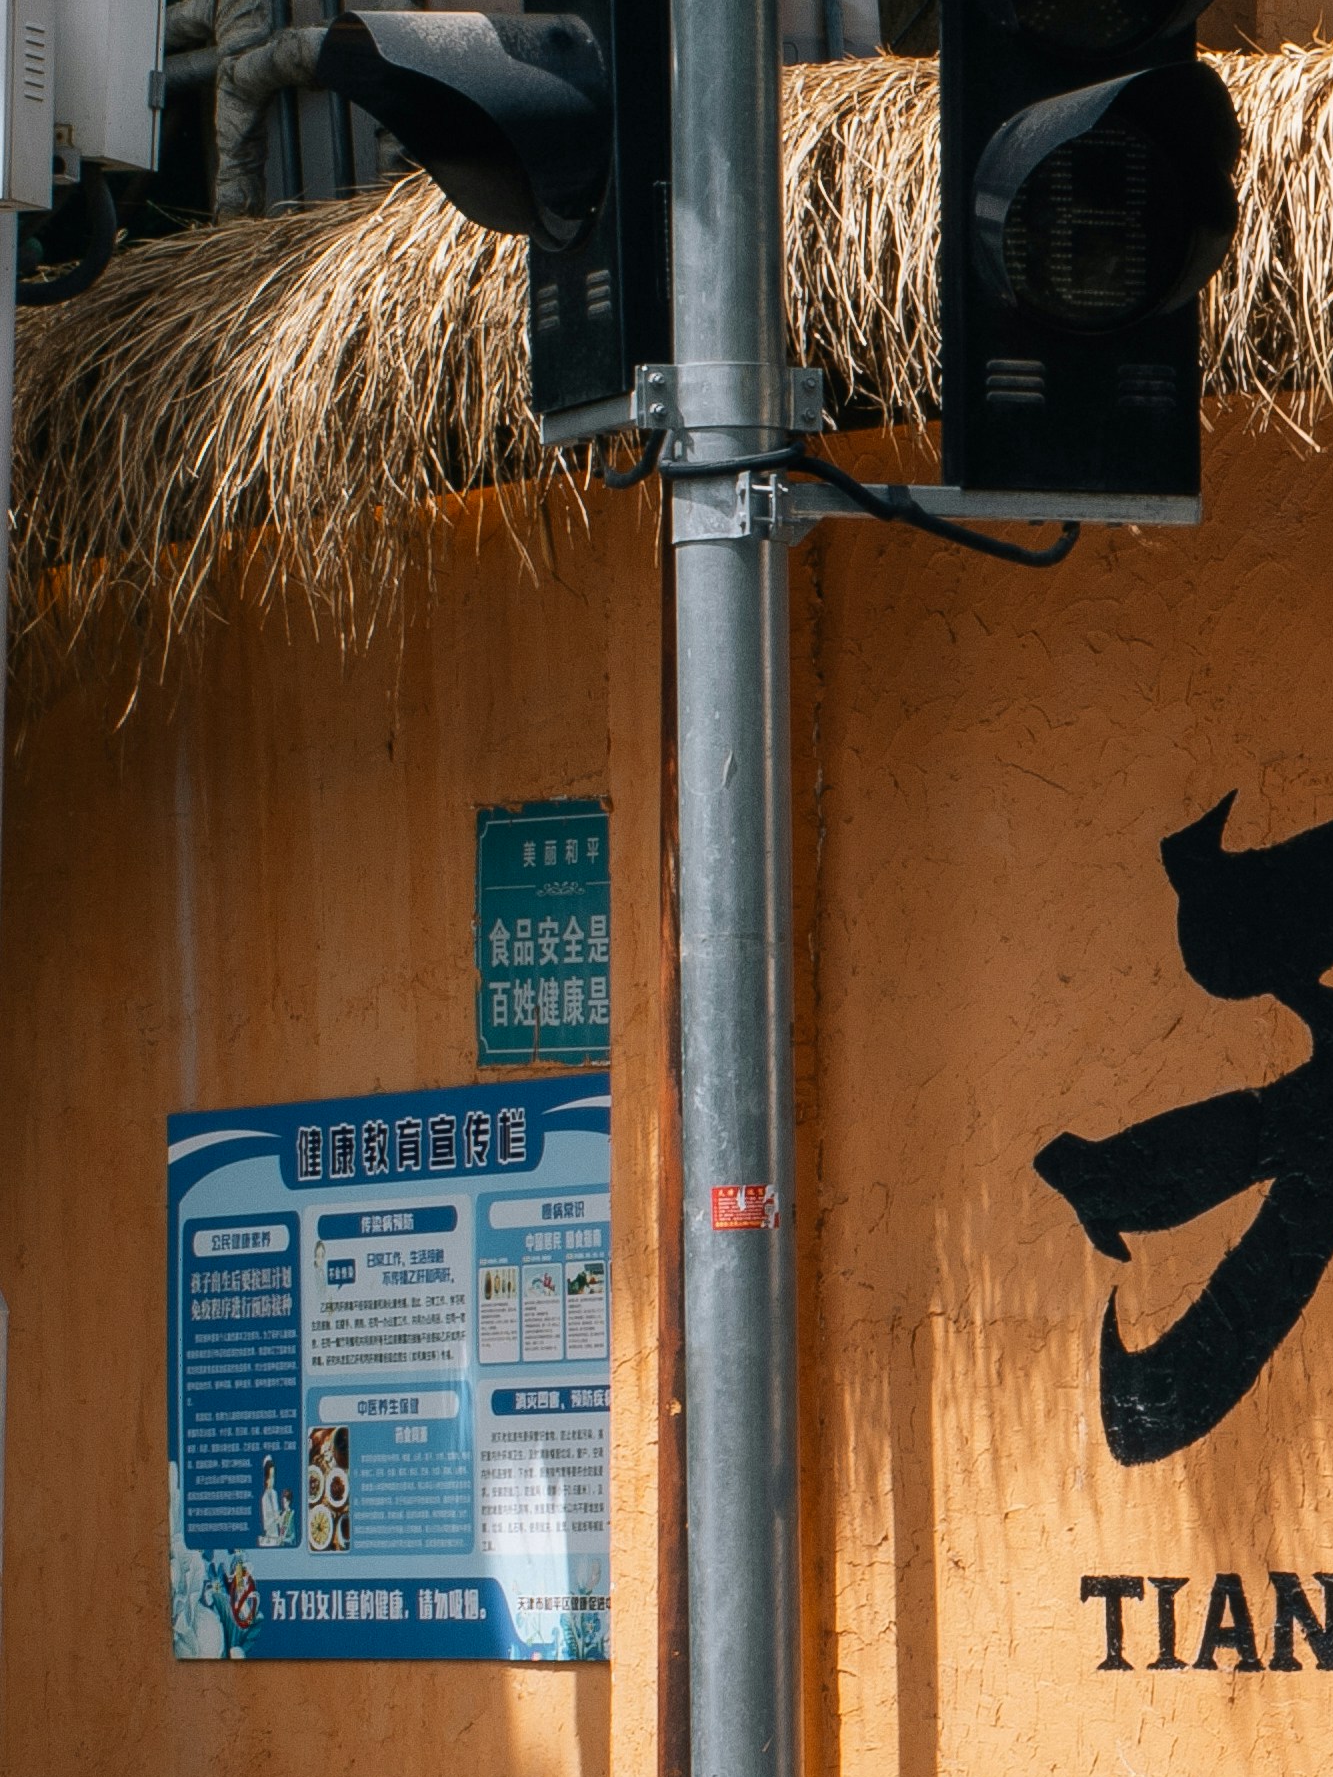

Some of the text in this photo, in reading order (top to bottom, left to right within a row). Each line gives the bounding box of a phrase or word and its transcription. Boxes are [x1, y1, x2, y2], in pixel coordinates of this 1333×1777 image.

[523, 837, 600, 867] 美丽和平
[489, 915, 609, 967] 食品安全是
[488, 976, 609, 1026] 百姓健康是
[296, 1107, 527, 1182] 健康教育宣传栏
[361, 1213, 415, 1234] 传染病预防
[357, 1397, 420, 1417] 中医养生保健
